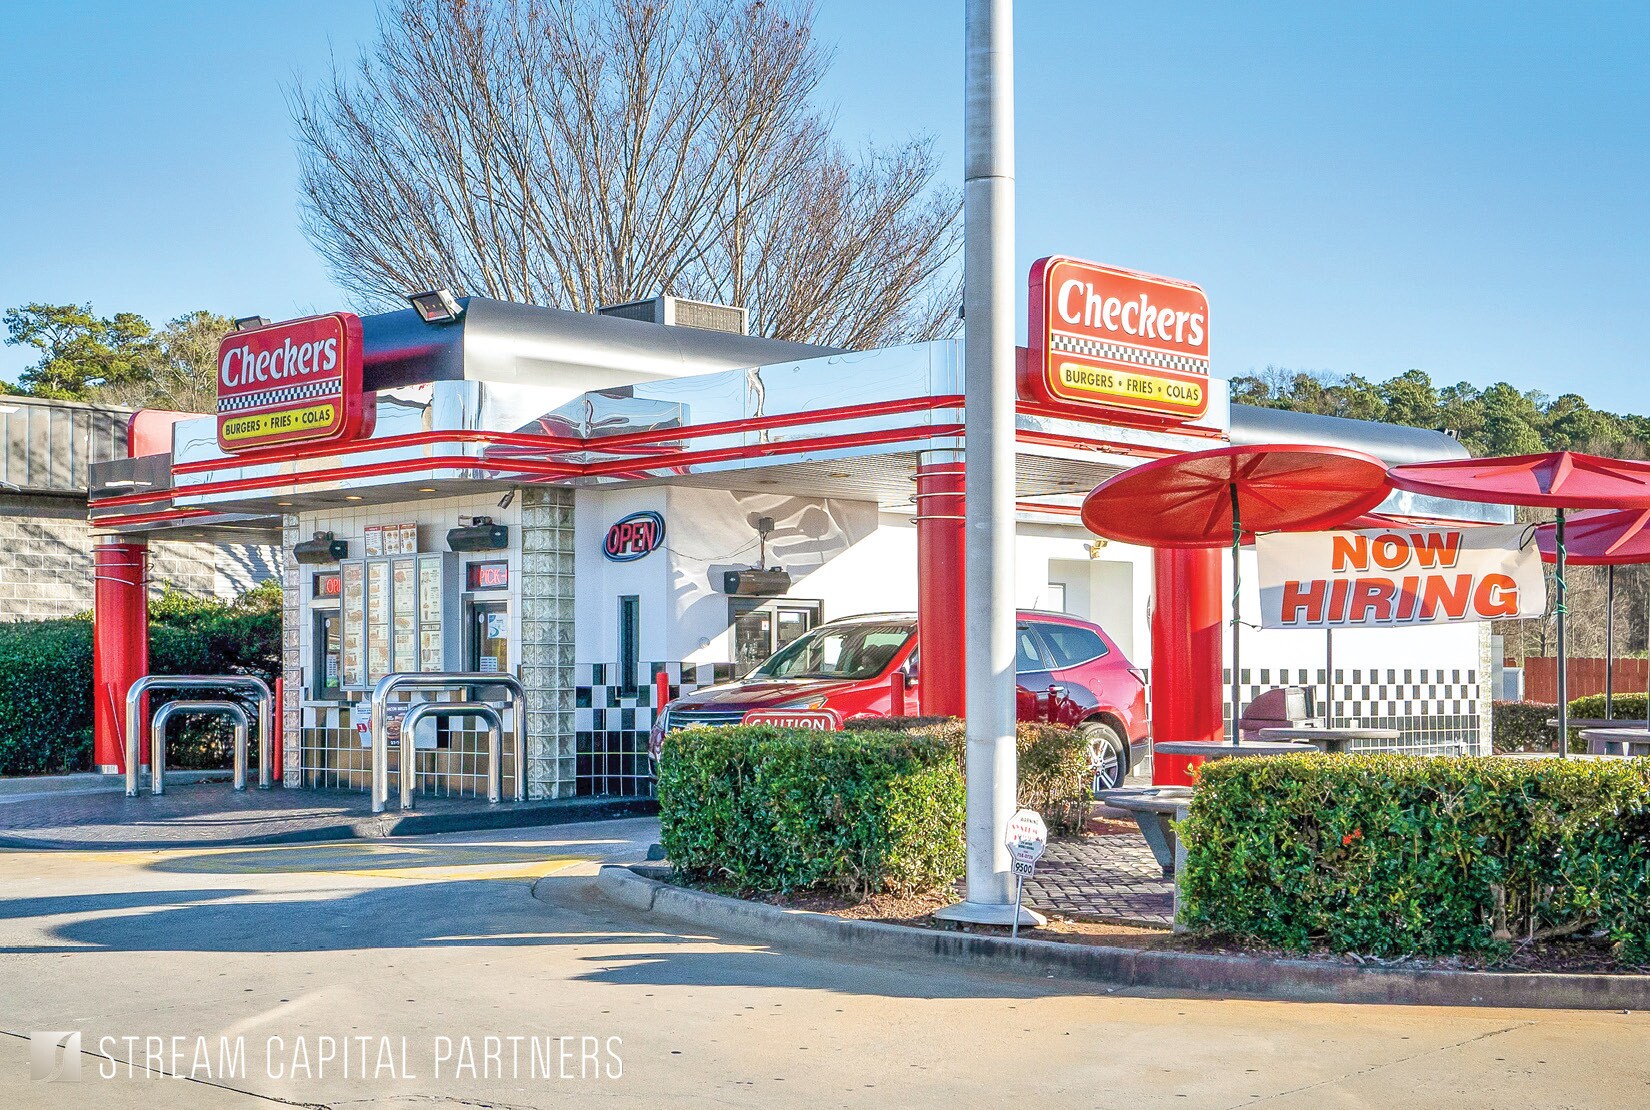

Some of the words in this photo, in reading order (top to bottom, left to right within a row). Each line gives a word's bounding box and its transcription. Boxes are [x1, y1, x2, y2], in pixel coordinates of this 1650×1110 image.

[1057, 279, 1204, 346] Checkers
[221, 337, 337, 387] Checkers
[1065, 369, 1114, 388] BURGERS
[1126, 378, 1153, 394] FRIES
[1166, 385, 1199, 401] COLAS
[225, 419, 261, 436] BURGERS
[270, 414, 292, 429] FRIES
[301, 409, 331, 424] COLAS
[606, 520, 656, 554] OPEN
[1331, 531, 1462, 572] NOW
[1280, 573, 1520, 625] HIRING
[1015, 862, 1033, 874] 9500
